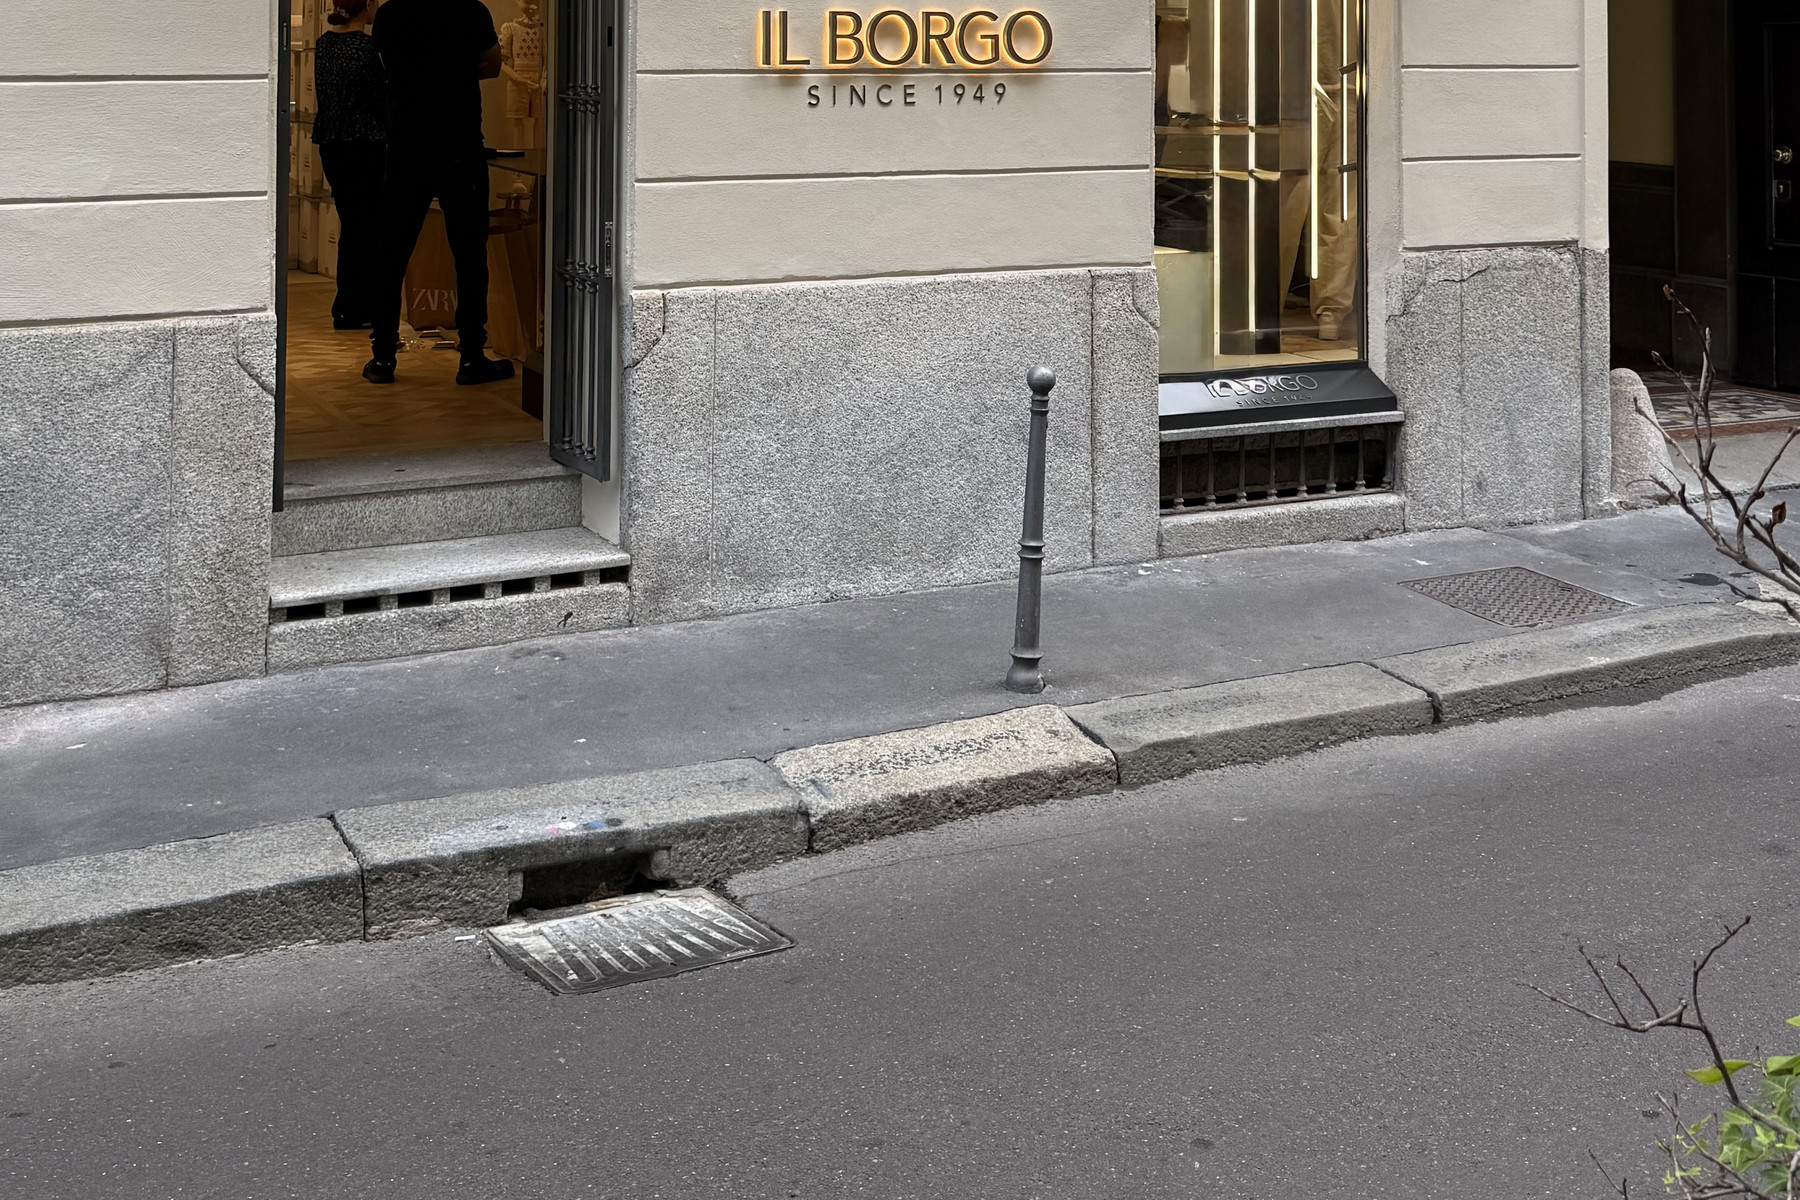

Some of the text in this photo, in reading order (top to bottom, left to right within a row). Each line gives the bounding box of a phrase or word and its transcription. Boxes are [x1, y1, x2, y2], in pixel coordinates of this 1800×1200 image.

[760, 9, 1053, 66] IL BORGO
[807, 82, 1006, 106] SINCE 1949
[1231, 374, 1318, 396] ORGO
